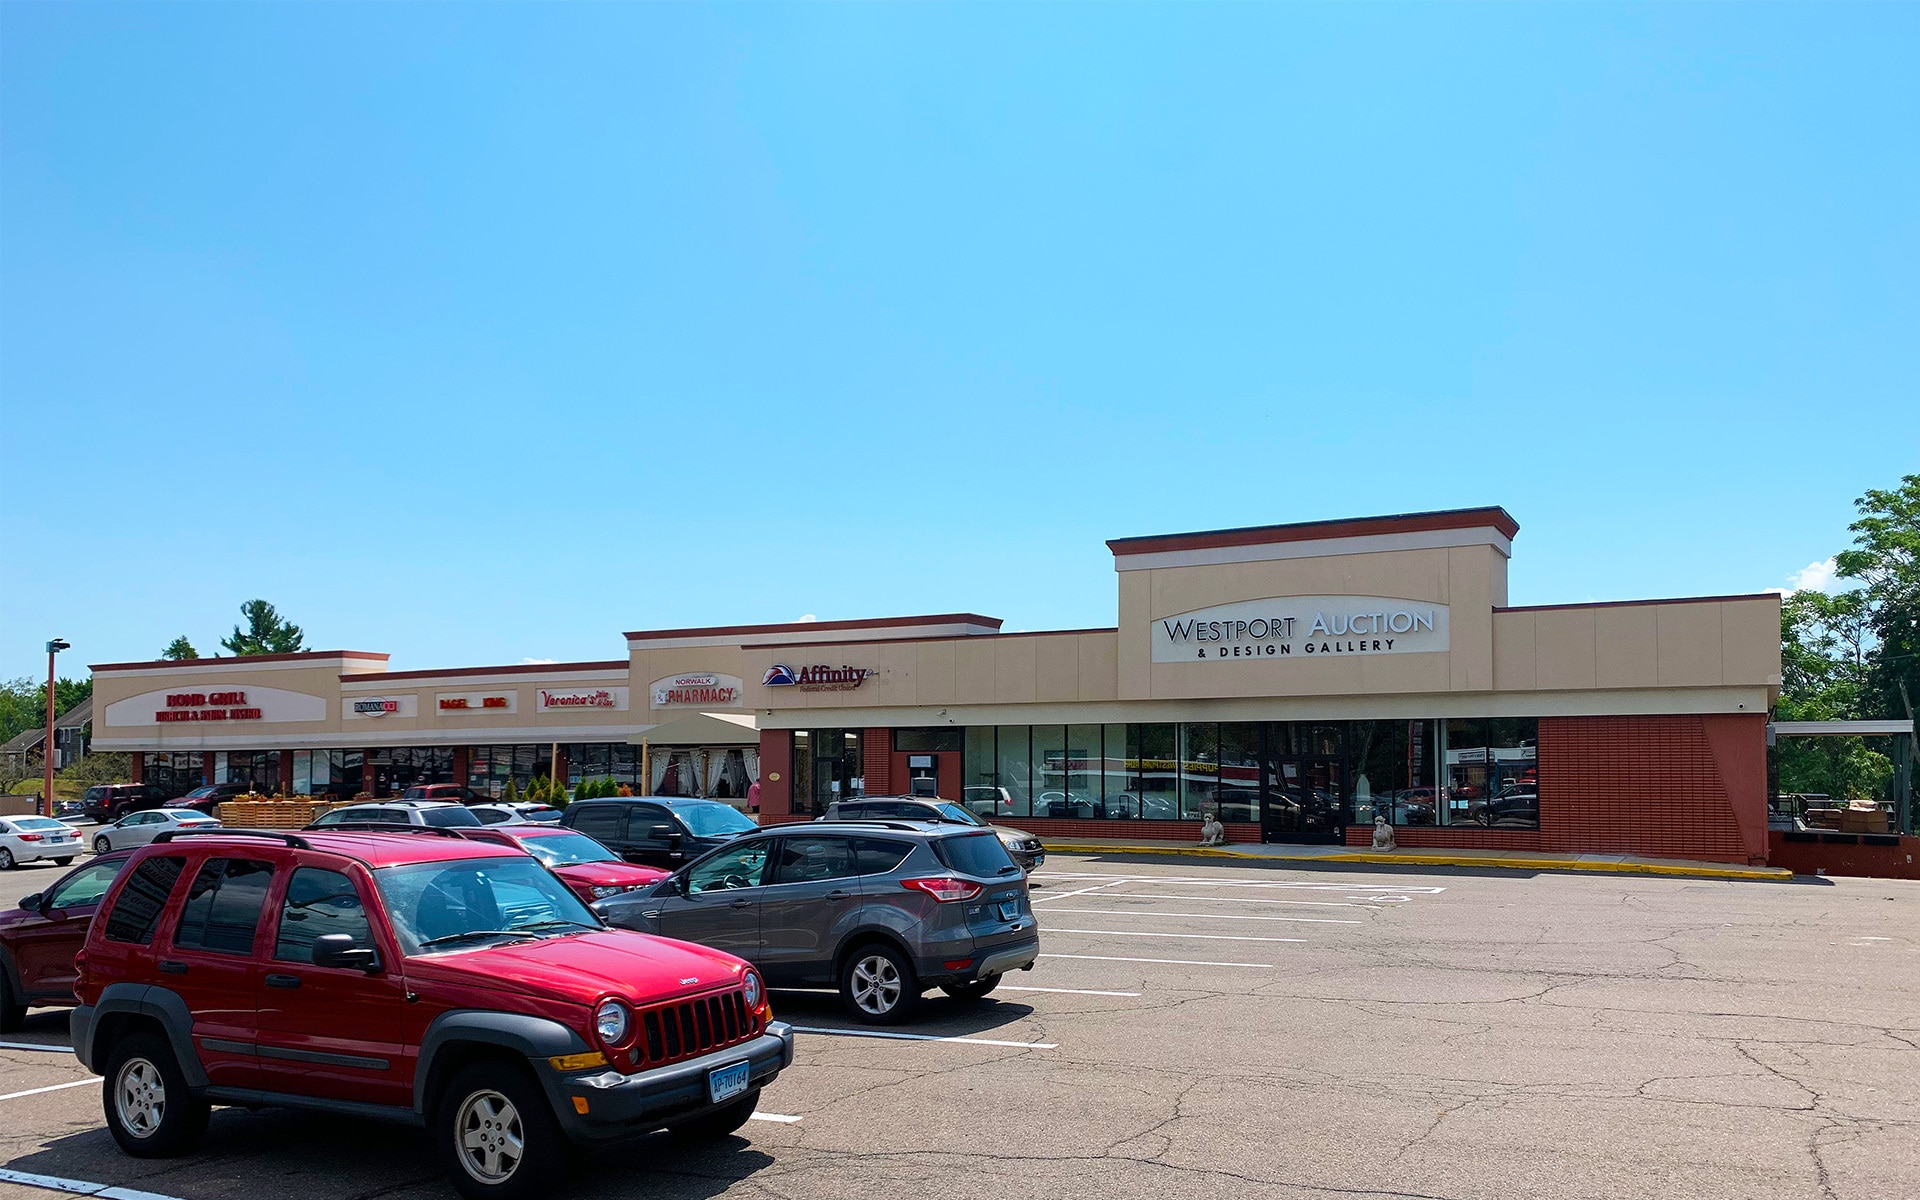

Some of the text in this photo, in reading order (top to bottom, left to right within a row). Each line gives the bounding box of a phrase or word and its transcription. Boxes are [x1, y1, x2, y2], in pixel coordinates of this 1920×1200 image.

[1163, 610, 1435, 642] WESTPORT AUCTION
[1197, 639, 1395, 658] & DESIGN GALLERY
[798, 664, 867, 687] Affinity
[166, 691, 247, 707] BOND GRILL
[541, 690, 596, 707] Veronica's
[668, 687, 734, 703] PHARMACY
